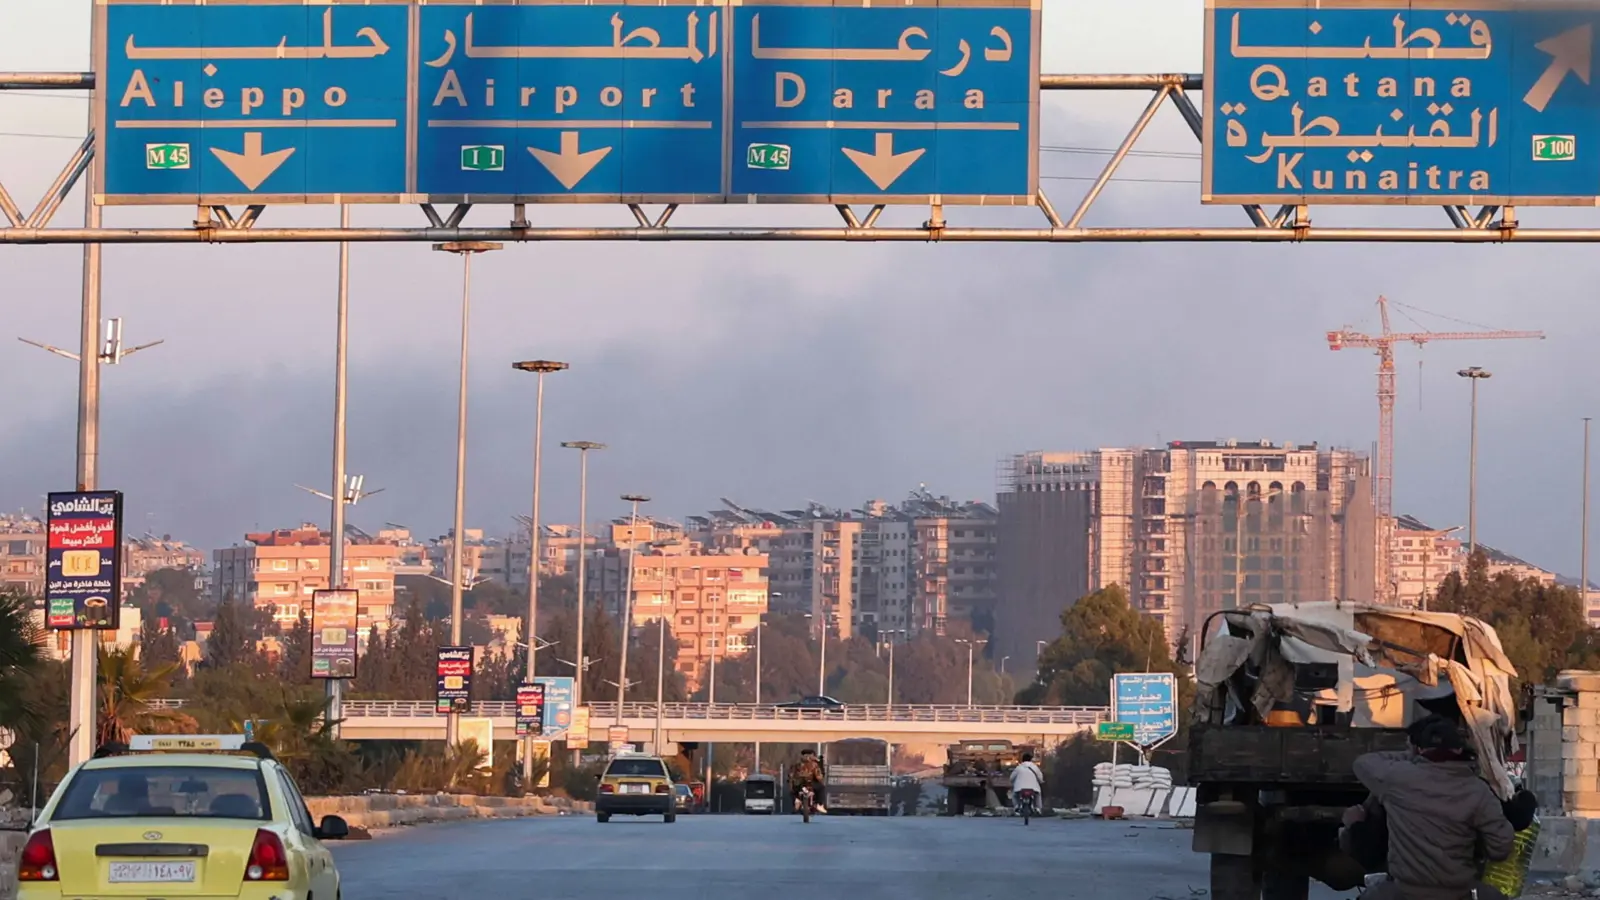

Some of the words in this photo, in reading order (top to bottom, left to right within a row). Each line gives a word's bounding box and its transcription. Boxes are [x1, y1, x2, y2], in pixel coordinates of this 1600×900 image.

[424, 10, 717, 68] المطار
[752, 12, 1012, 77] درعا
[1230, 12, 1492, 60] قطنا
[120, 69, 347, 115] Aleppo
[432, 69, 696, 114] Airport
[775, 71, 984, 110] Daraa
[1250, 64, 1471, 101] Qatana
[1220, 101, 1497, 164] القنيطرة
[1535, 141, 1546, 155] P
[1550, 140, 1573, 156] 100
[149, 148, 166, 165] M
[169, 148, 188, 165] 45
[490, 150, 497, 165] 1
[749, 148, 766, 164] M
[770, 150, 788, 165] 45
[1276, 153, 1490, 190] Kunaitra
[51, 496, 100, 516] الشامي
